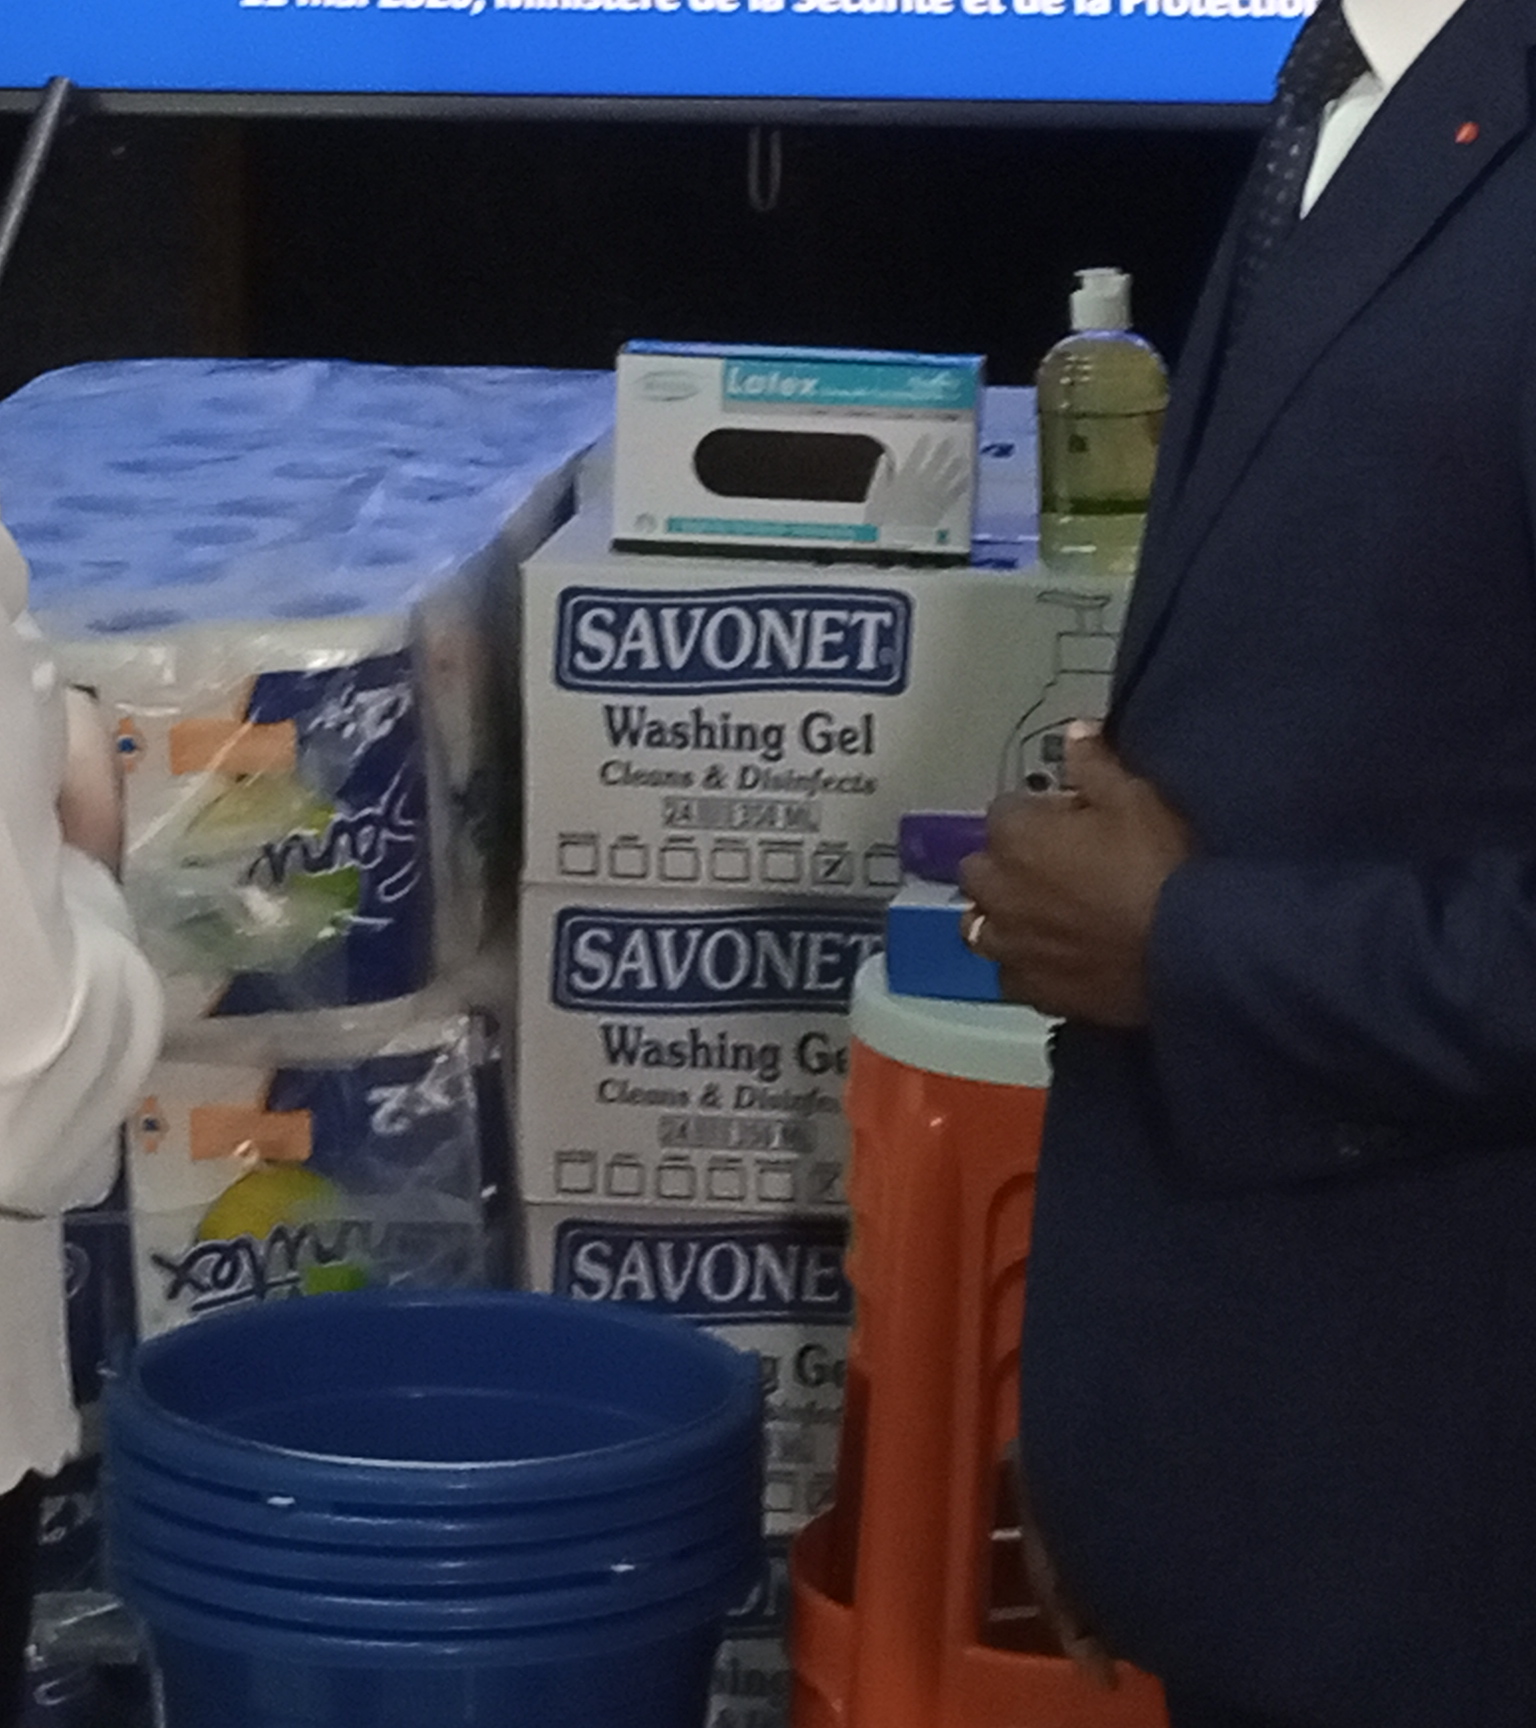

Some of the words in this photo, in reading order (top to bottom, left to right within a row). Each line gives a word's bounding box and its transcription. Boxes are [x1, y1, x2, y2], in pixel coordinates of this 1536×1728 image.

[572, 606, 892, 672] SAVONET
[603, 704, 786, 762] Washing
[801, 711, 875, 755] Gel
[599, 759, 694, 788] Cleans
[700, 764, 725, 790] &
[735, 765, 877, 798] Disinfects
[600, 1024, 782, 1083] Washing
[797, 1031, 850, 1075] Ge
[569, 1240, 842, 1303] SAVONE
